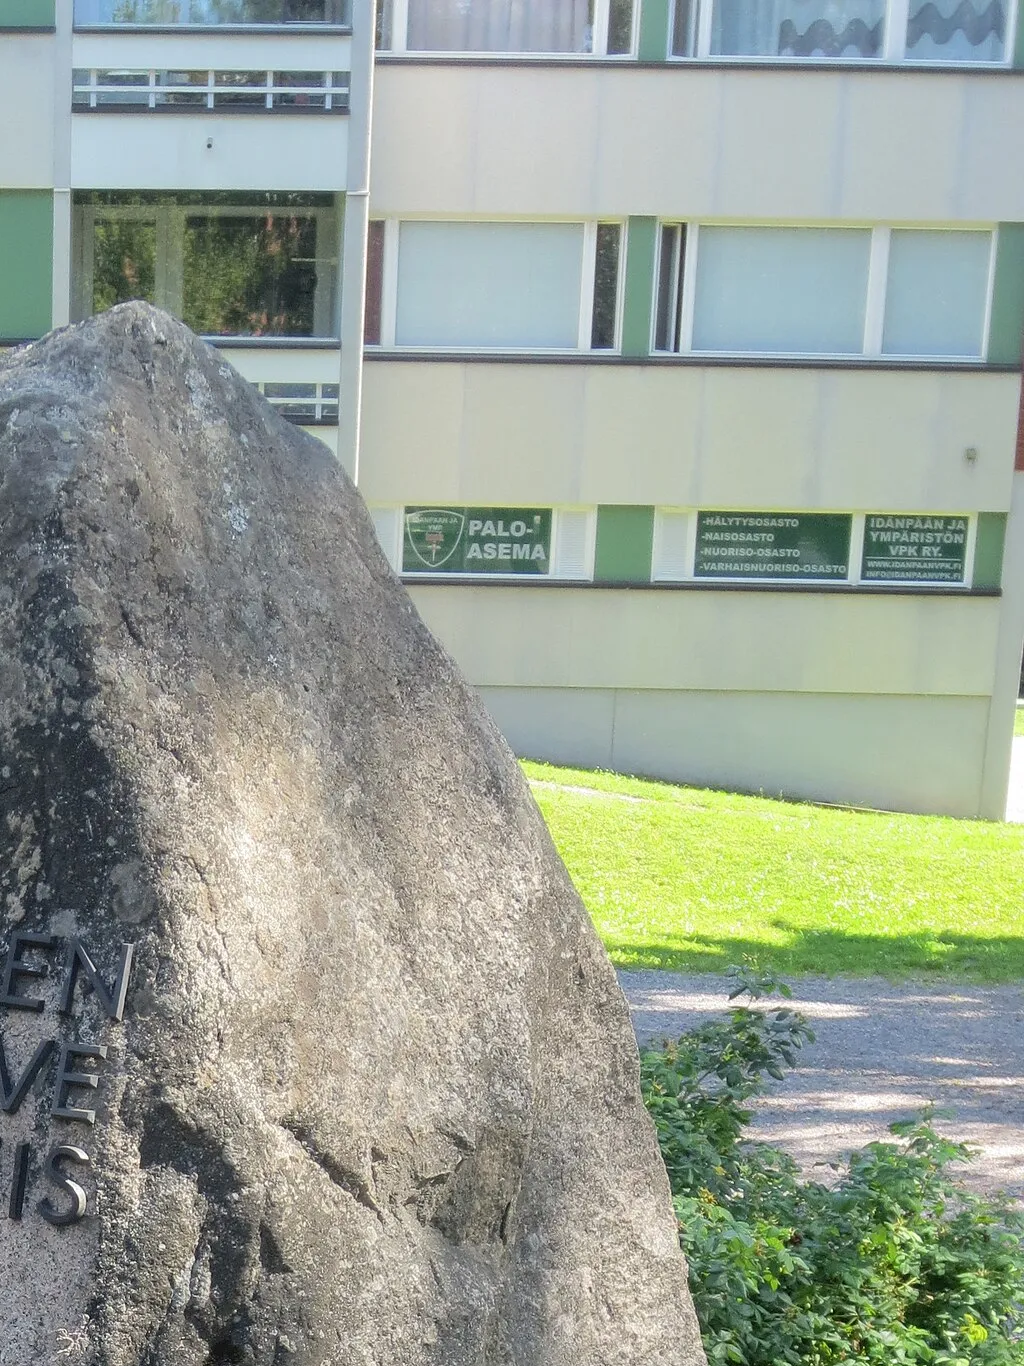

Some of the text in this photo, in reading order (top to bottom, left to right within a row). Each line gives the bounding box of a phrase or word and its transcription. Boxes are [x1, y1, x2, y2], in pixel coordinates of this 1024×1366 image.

[469, 520, 533, 537] PALO-
[870, 516, 966, 530] IDÄNPÄÄN JA
[702, 531, 775, 542] -NAISOSASTO
[870, 530, 964, 544] YMPÄRISTÖN
[466, 543, 547, 560] ASEMA
[701, 547, 801, 558] -NUORISO-OSASTO
[889, 545, 943, 557] VPK RY.
